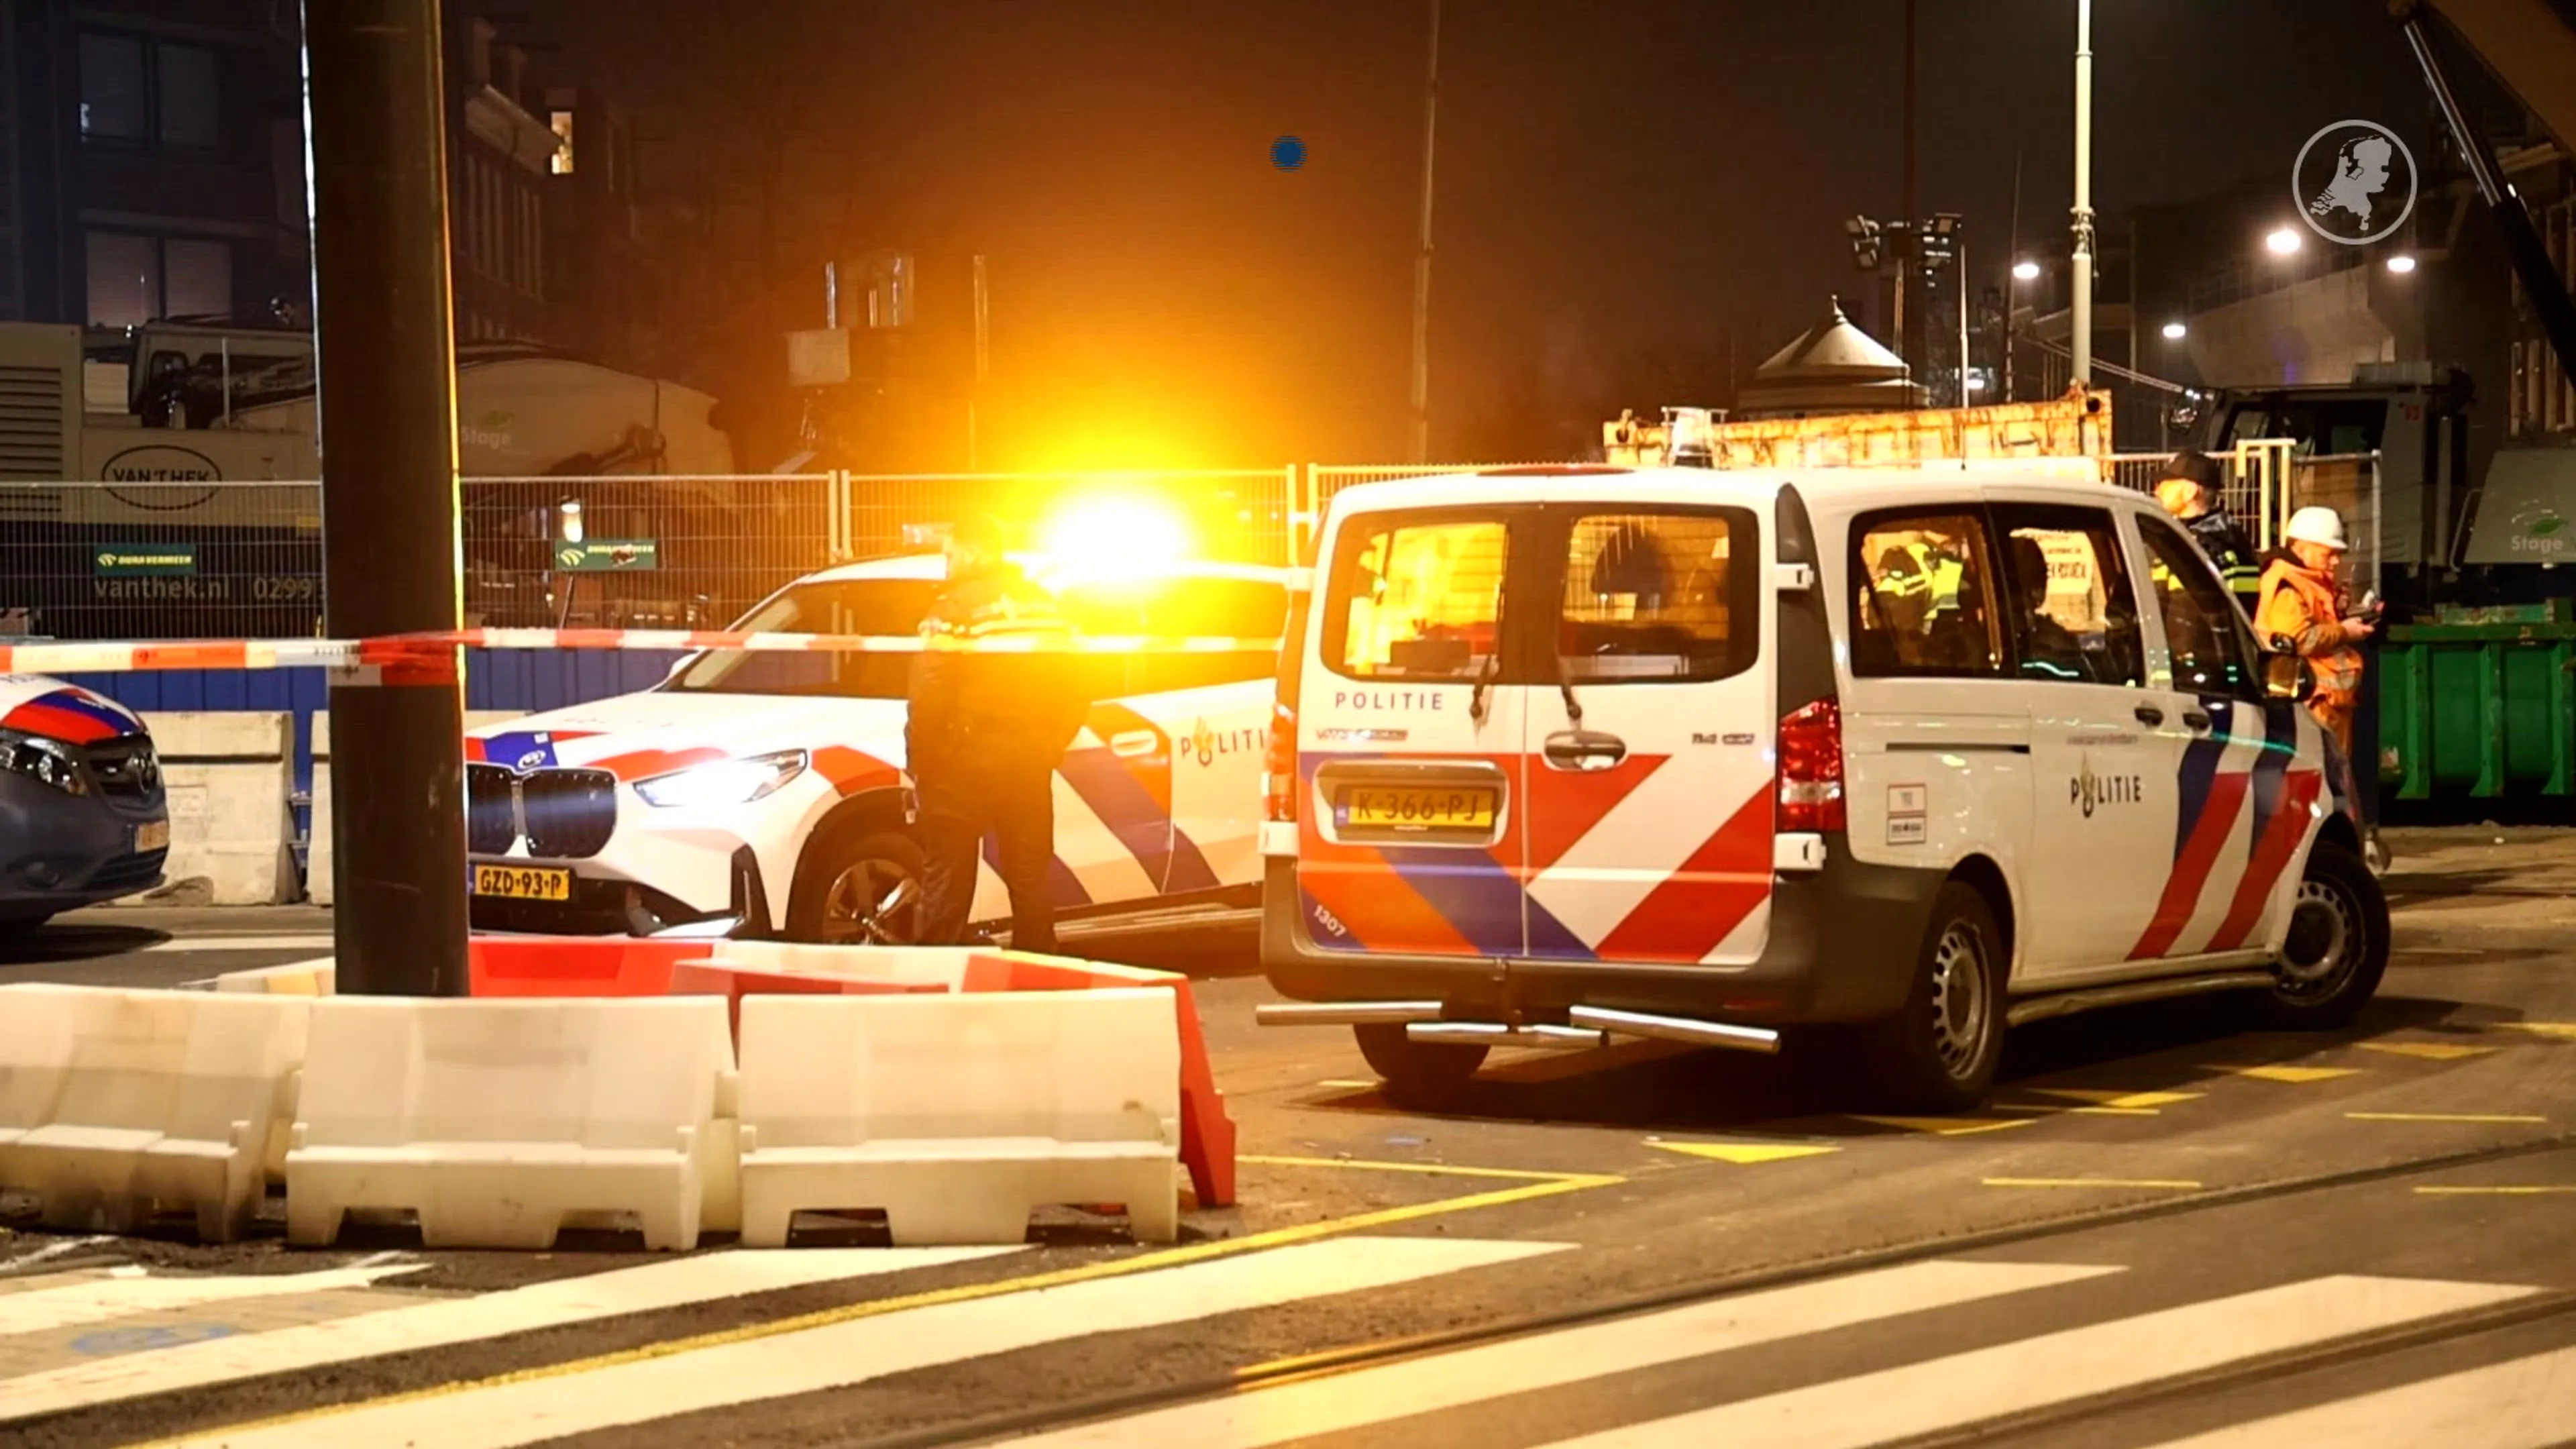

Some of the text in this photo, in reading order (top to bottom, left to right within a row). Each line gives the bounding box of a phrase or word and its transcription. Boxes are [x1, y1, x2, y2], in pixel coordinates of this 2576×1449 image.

[2511, 535, 2564, 554] Stage
[94, 574, 313, 599] vanthek.nl 0299
[1336, 691, 1443, 710] POLITIE
[1181, 727, 1264, 768] POLITI
[1358, 793, 1479, 822] K-366-PJ
[2071, 774, 2141, 819] POLITIE
[480, 869, 561, 896] GZD-93-P
[1313, 904, 1346, 936] 1307
